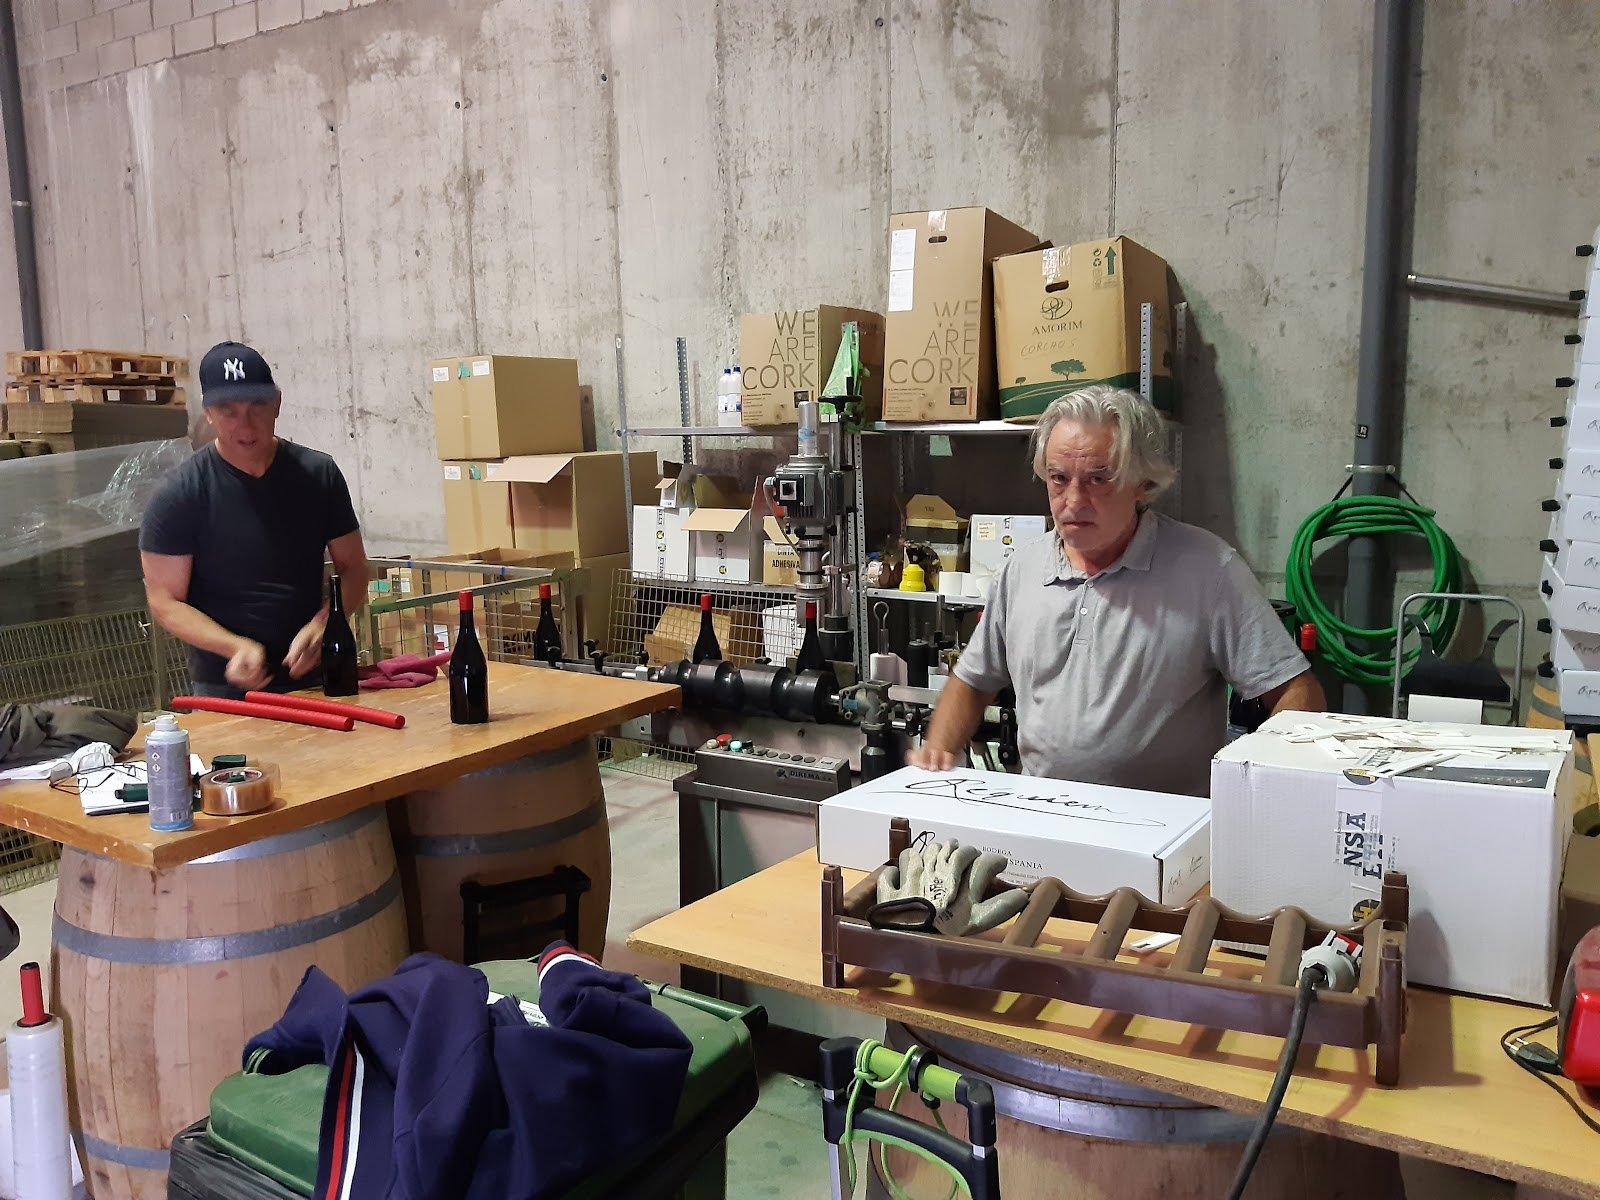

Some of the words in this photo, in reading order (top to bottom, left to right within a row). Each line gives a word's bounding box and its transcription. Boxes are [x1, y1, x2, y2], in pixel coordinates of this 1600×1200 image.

[774, 309, 816, 336] WE
[934, 300, 978, 327] WE
[1032, 320, 1083, 336] AMORIM
[768, 335, 816, 363] ARE
[923, 329, 977, 356] ARE
[223, 357, 246, 381] NY
[742, 362, 815, 390] CORK
[888, 357, 974, 384] CORK
[771, 559, 801, 569] ADHESIVA
[982, 845, 1012, 857] BODEGA
[1008, 858, 1044, 871] SPANIA
